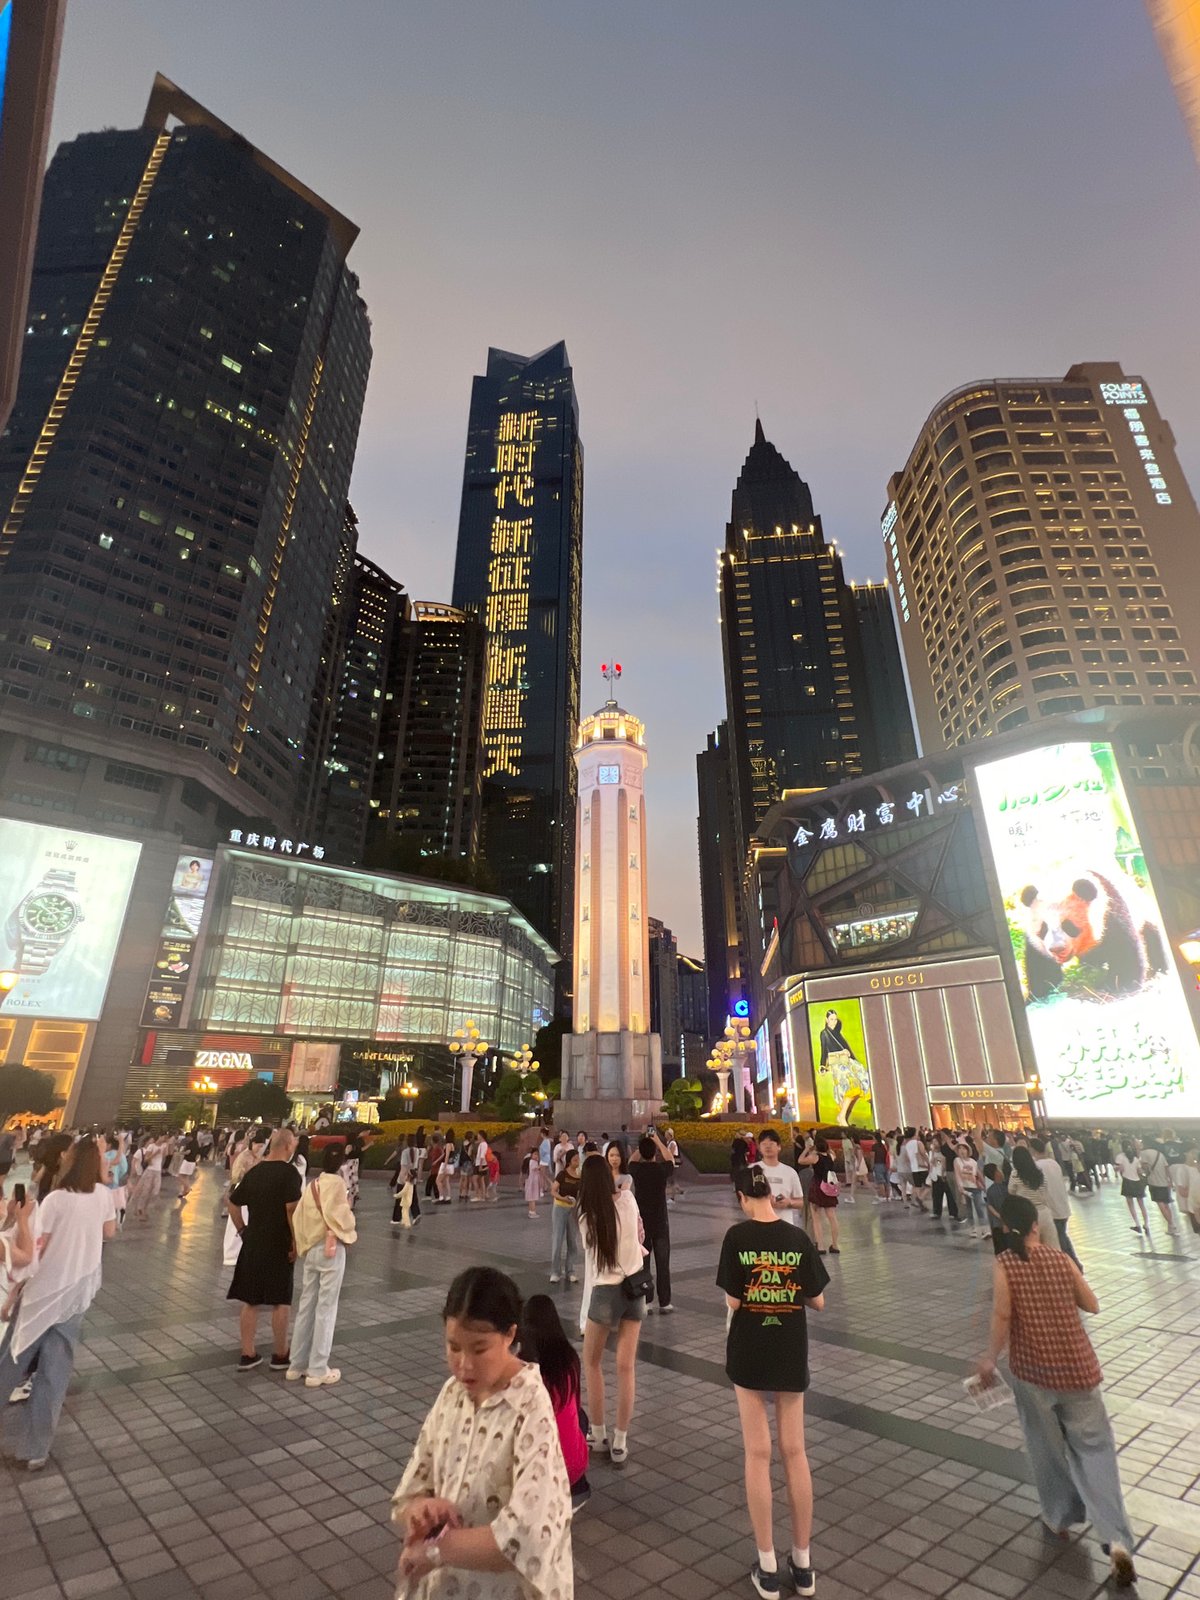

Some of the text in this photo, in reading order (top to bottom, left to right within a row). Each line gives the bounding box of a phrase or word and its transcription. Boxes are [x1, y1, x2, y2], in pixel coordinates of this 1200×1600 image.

[1100, 383, 1132, 391] FOUR
[1102, 391, 1146, 399] POINTS
[792, 785, 959, 847] 金鹰财富中心
[229, 829, 325, 859] 重庆时代广场
[870, 972, 924, 989] GUCCI
[6, 998, 42, 1008] ROLEX
[195, 1051, 253, 1070] ZEGNA
[352, 1051, 378, 1060] SAINT
[960, 1089, 994, 1098] GUCCI
[762, 1269, 782, 1284] DA
[746, 1289, 797, 1303] MONEY
